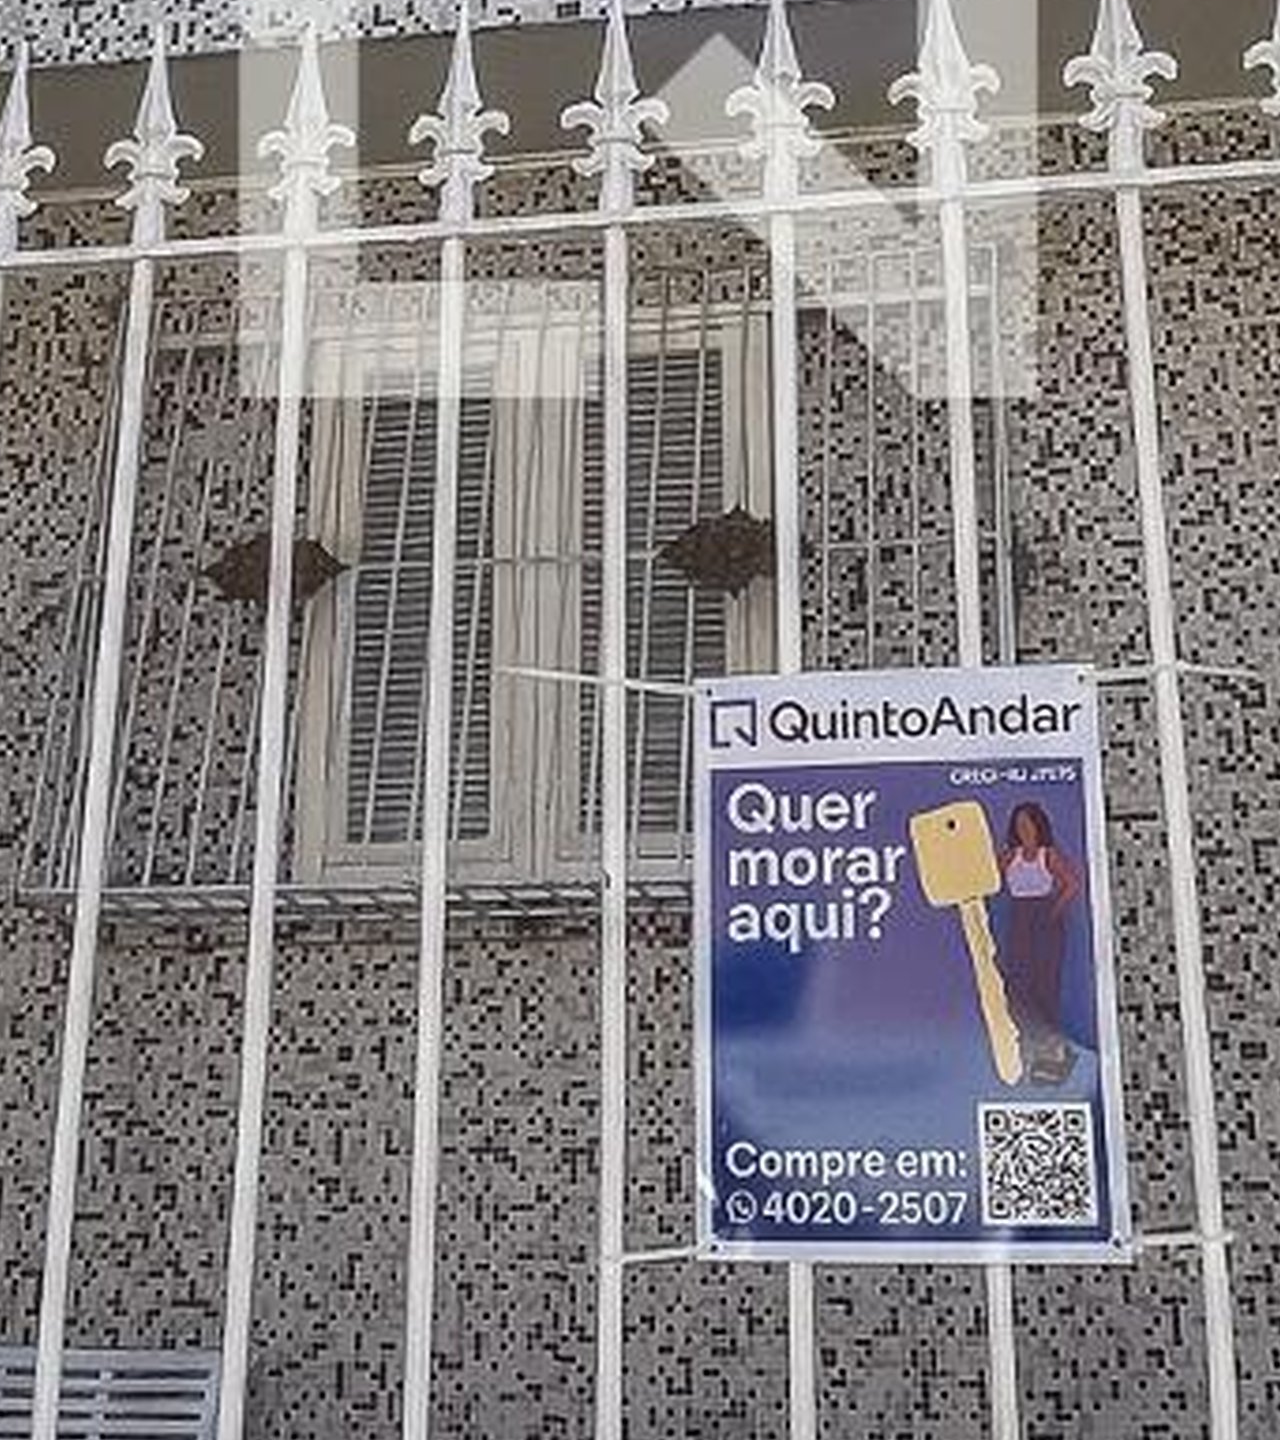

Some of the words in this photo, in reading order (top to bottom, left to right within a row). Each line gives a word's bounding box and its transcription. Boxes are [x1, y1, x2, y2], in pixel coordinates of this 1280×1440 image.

[769, 693, 1082, 744] QuintoAndar
[727, 782, 877, 834] Quer
[727, 844, 906, 887] morar
[727, 886, 892, 954] aqui?
[725, 1141, 887, 1187] Compre
[896, 1149, 968, 1179] em:
[762, 1190, 968, 1225] 4020-2507
